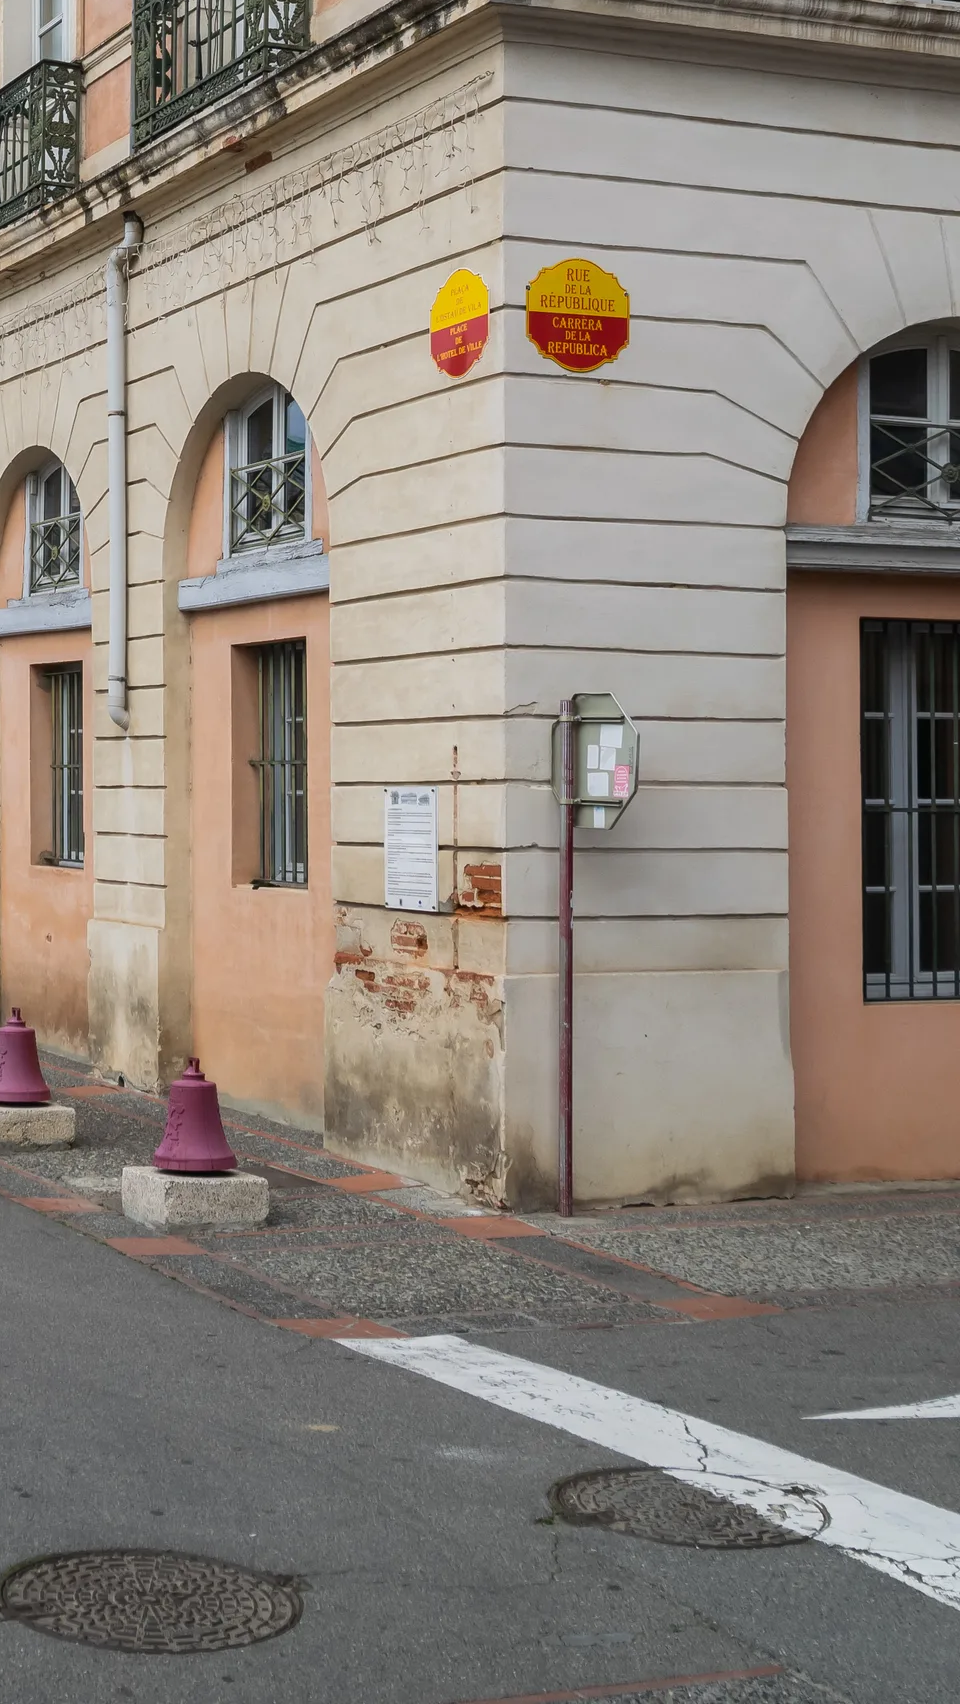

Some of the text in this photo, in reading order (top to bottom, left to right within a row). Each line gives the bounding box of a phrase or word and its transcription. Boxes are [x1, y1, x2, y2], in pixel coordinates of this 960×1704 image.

[567, 268, 590, 282] RUE
[565, 284, 591, 295] DE LA
[456, 297, 463, 306] DE
[540, 292, 616, 312] RÉPUBLIQUE
[459, 306, 467, 316] DE
[468, 302, 481, 313] VILA
[450, 323, 468, 336] PLACE
[552, 316, 602, 330] CARRÈRA
[455, 336, 462, 345] DE
[565, 330, 590, 341] DE LA
[459, 346, 466, 355] DE
[467, 341, 482, 352] VILLE
[548, 342, 607, 356] REPUBLICA
